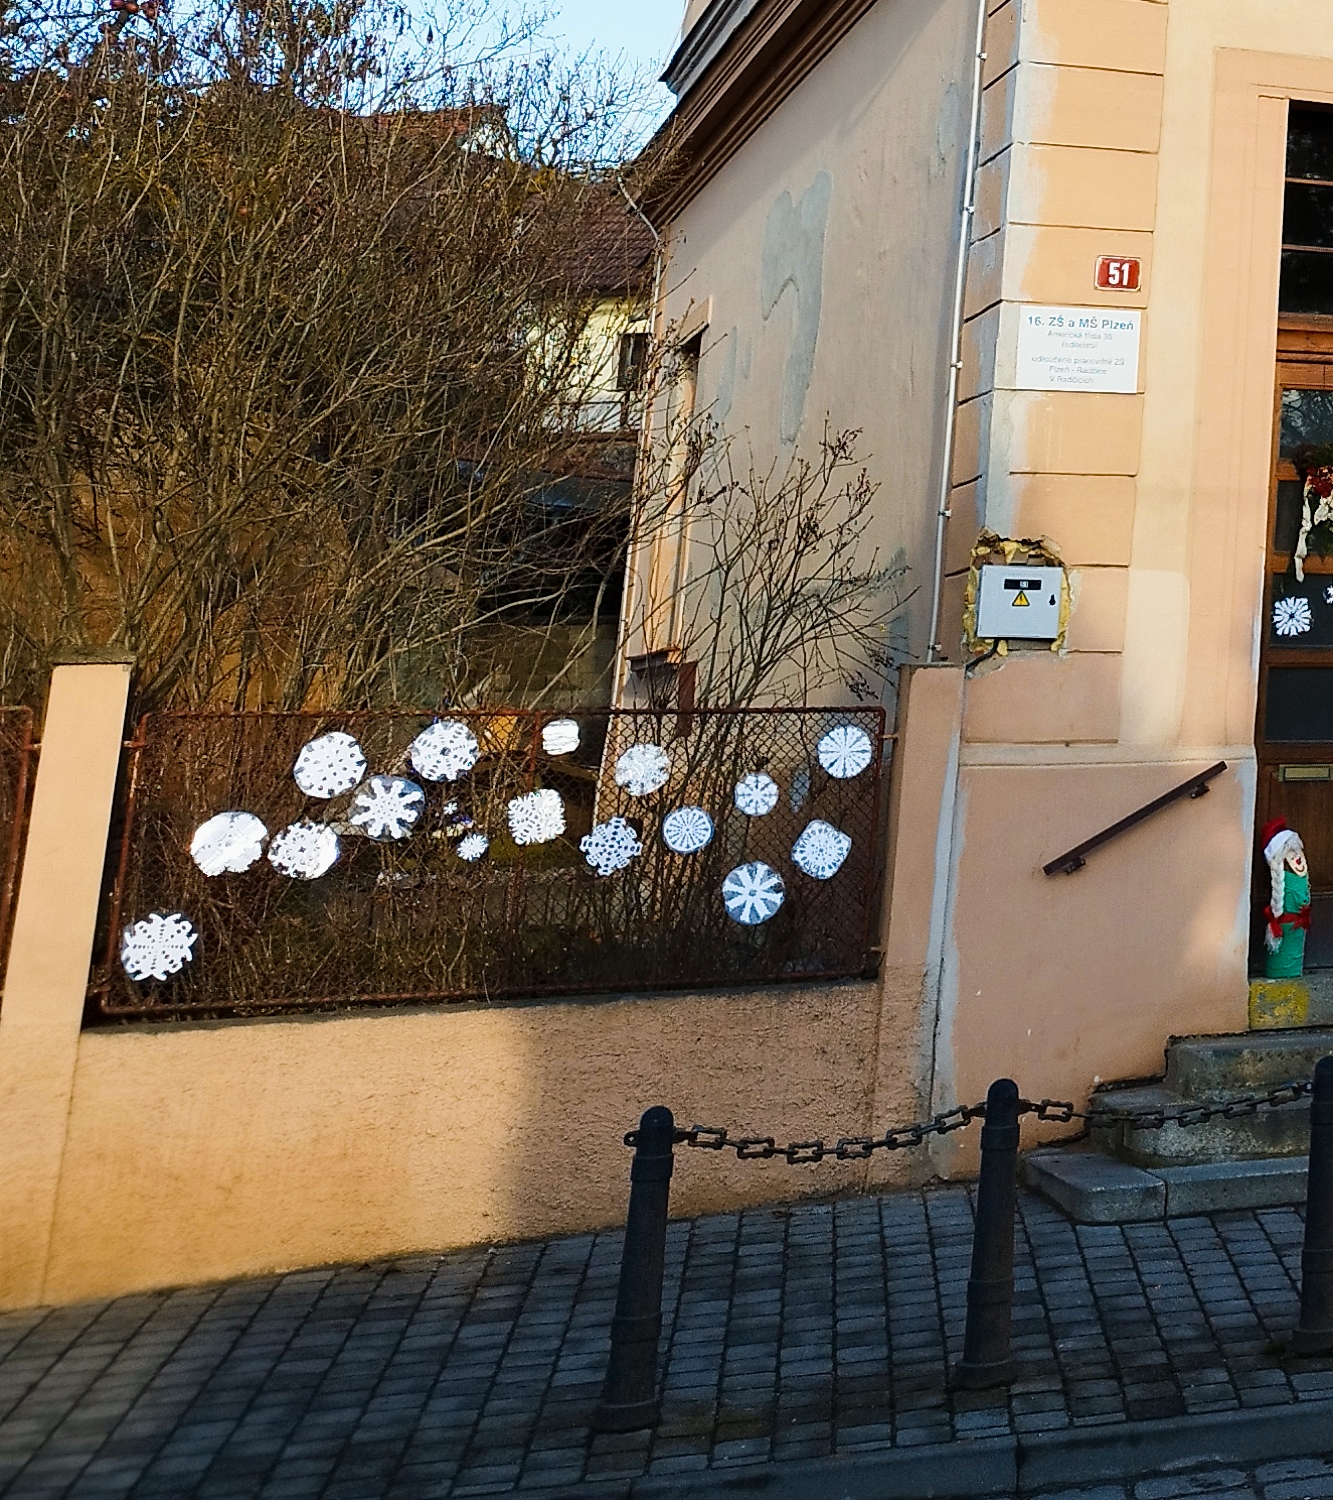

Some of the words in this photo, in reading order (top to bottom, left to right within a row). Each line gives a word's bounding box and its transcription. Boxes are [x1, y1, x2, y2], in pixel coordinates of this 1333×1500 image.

[1108, 262, 1130, 286] 51
[1028, 315, 1045, 327] 16.
[1048, 314, 1065, 328] ZŠ
[1068, 320, 1075, 328] a
[1079, 316, 1098, 329] MŠ
[1101, 318, 1134, 330] Plzeň
